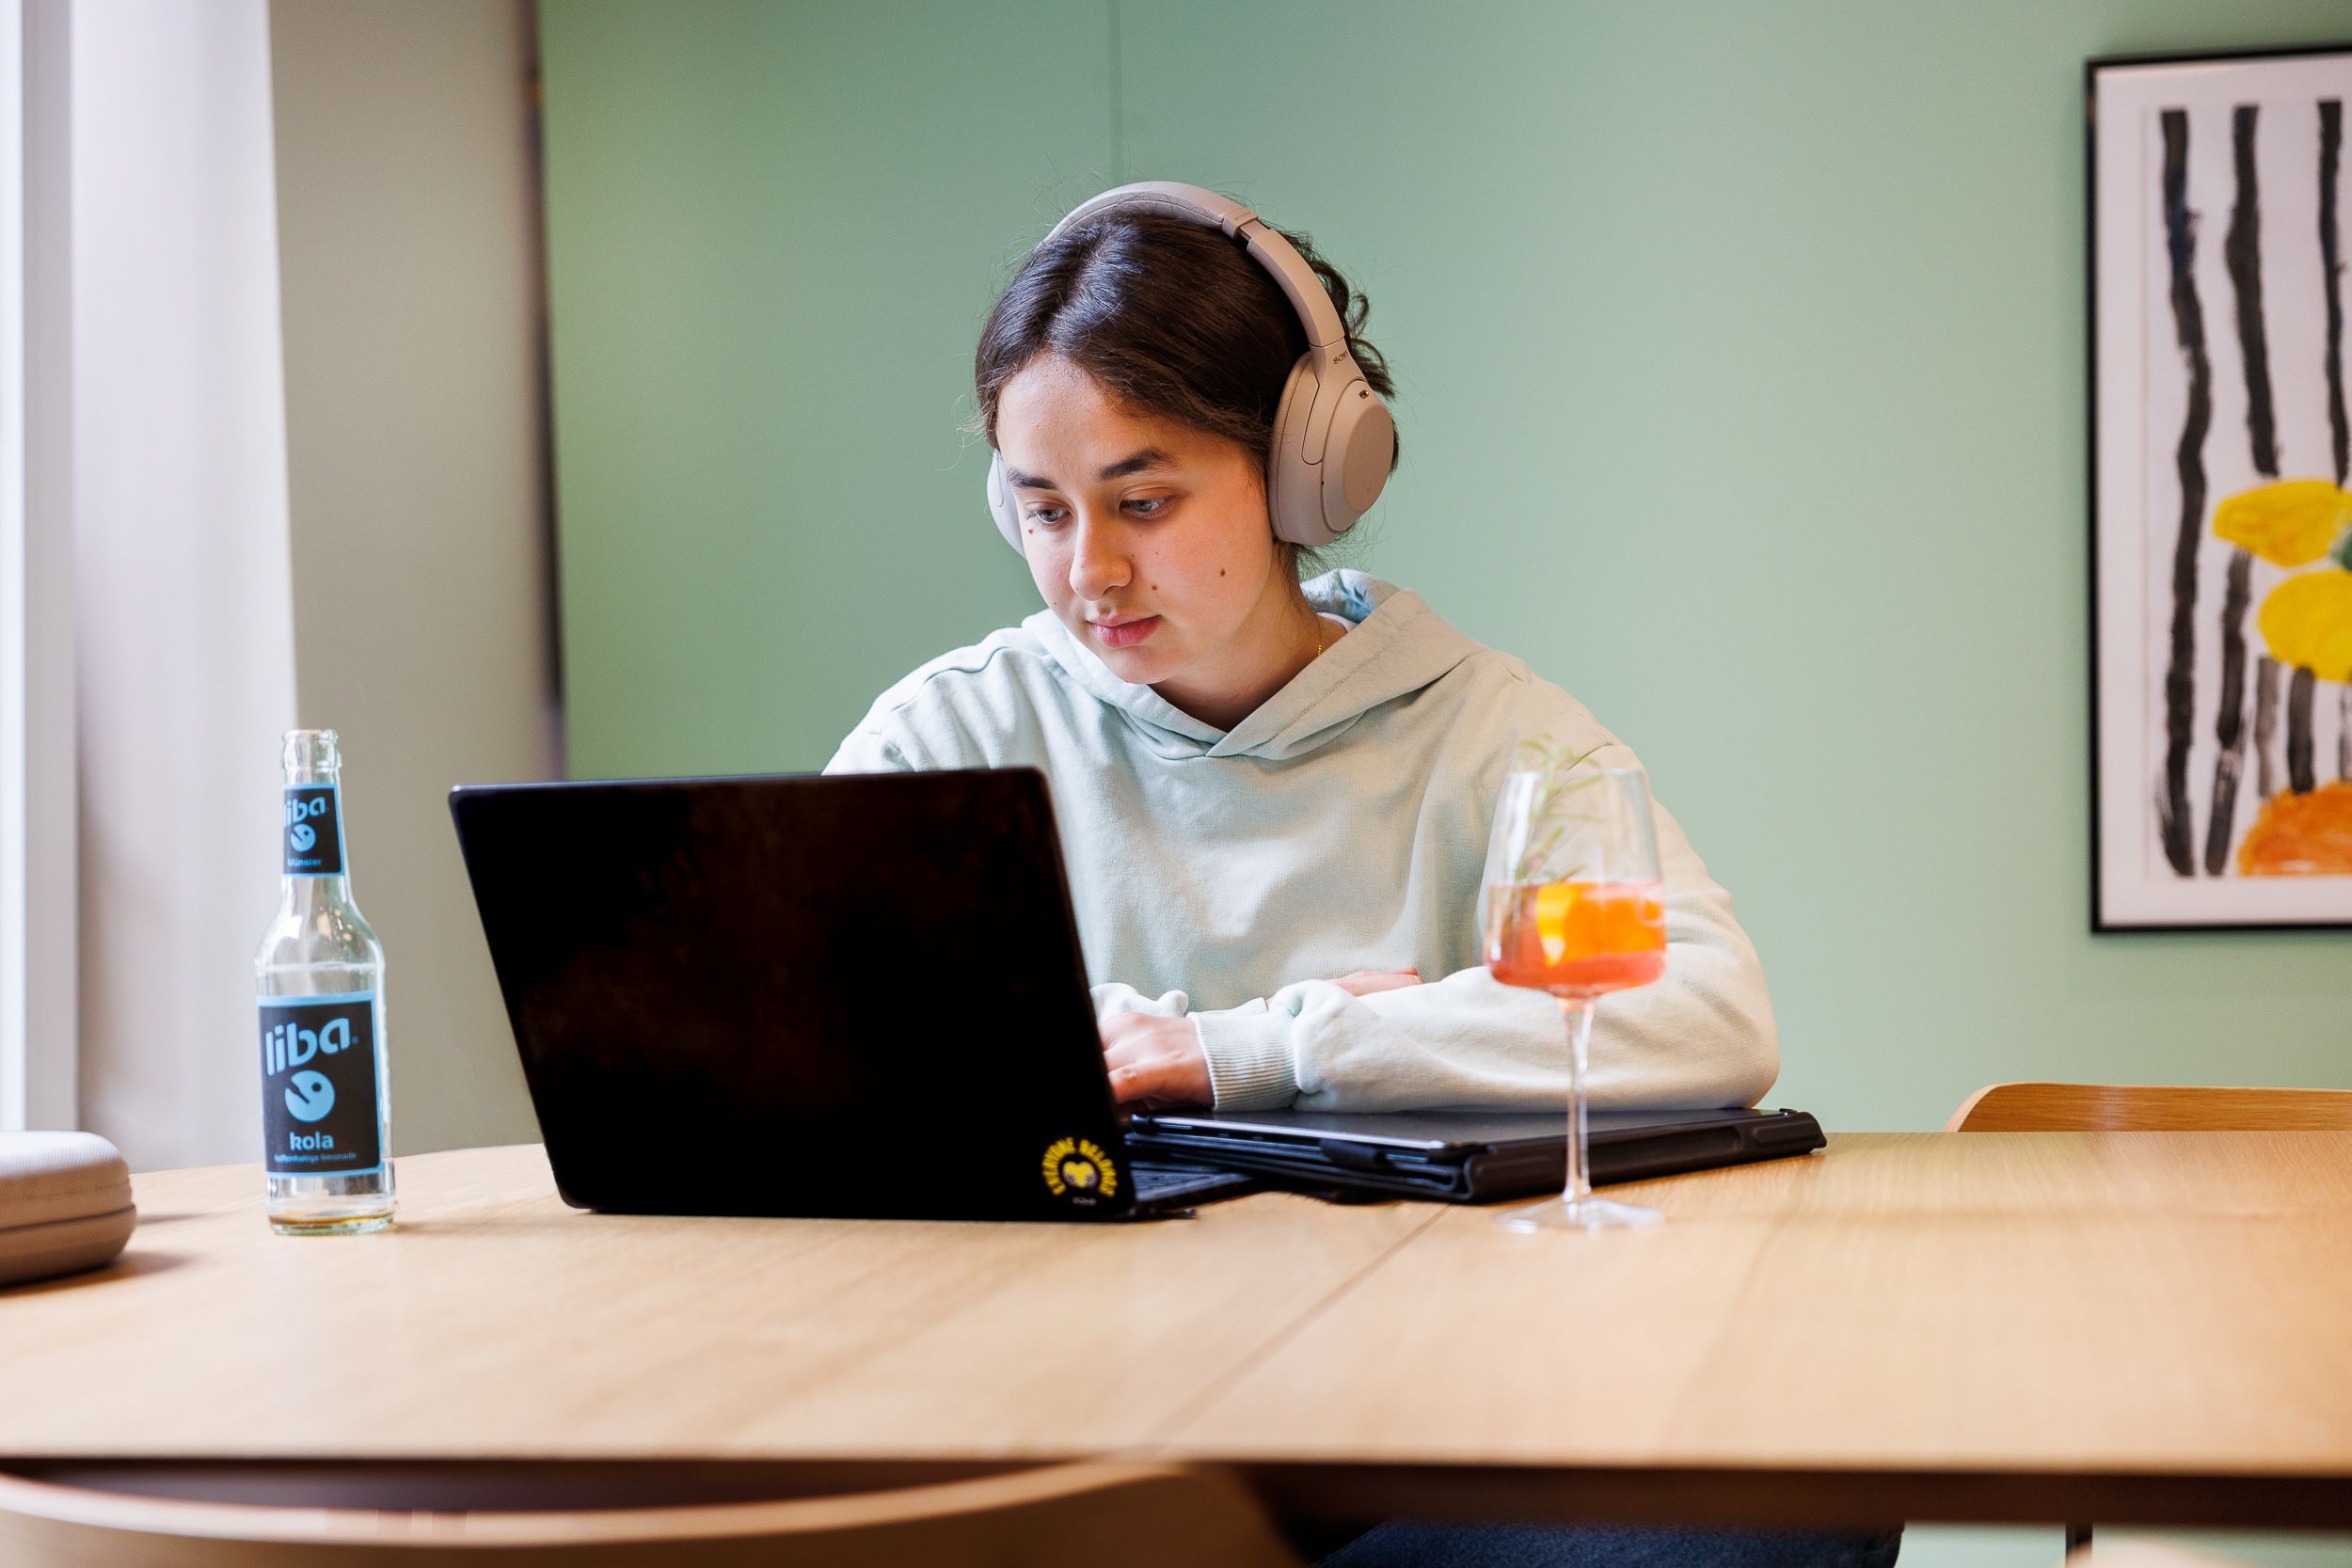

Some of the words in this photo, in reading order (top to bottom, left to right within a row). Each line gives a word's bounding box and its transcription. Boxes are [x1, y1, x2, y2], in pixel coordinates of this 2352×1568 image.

[1333, 348, 1349, 365] SONY
[265, 1017, 351, 1077] liba
[290, 1131, 334, 1151] kola
